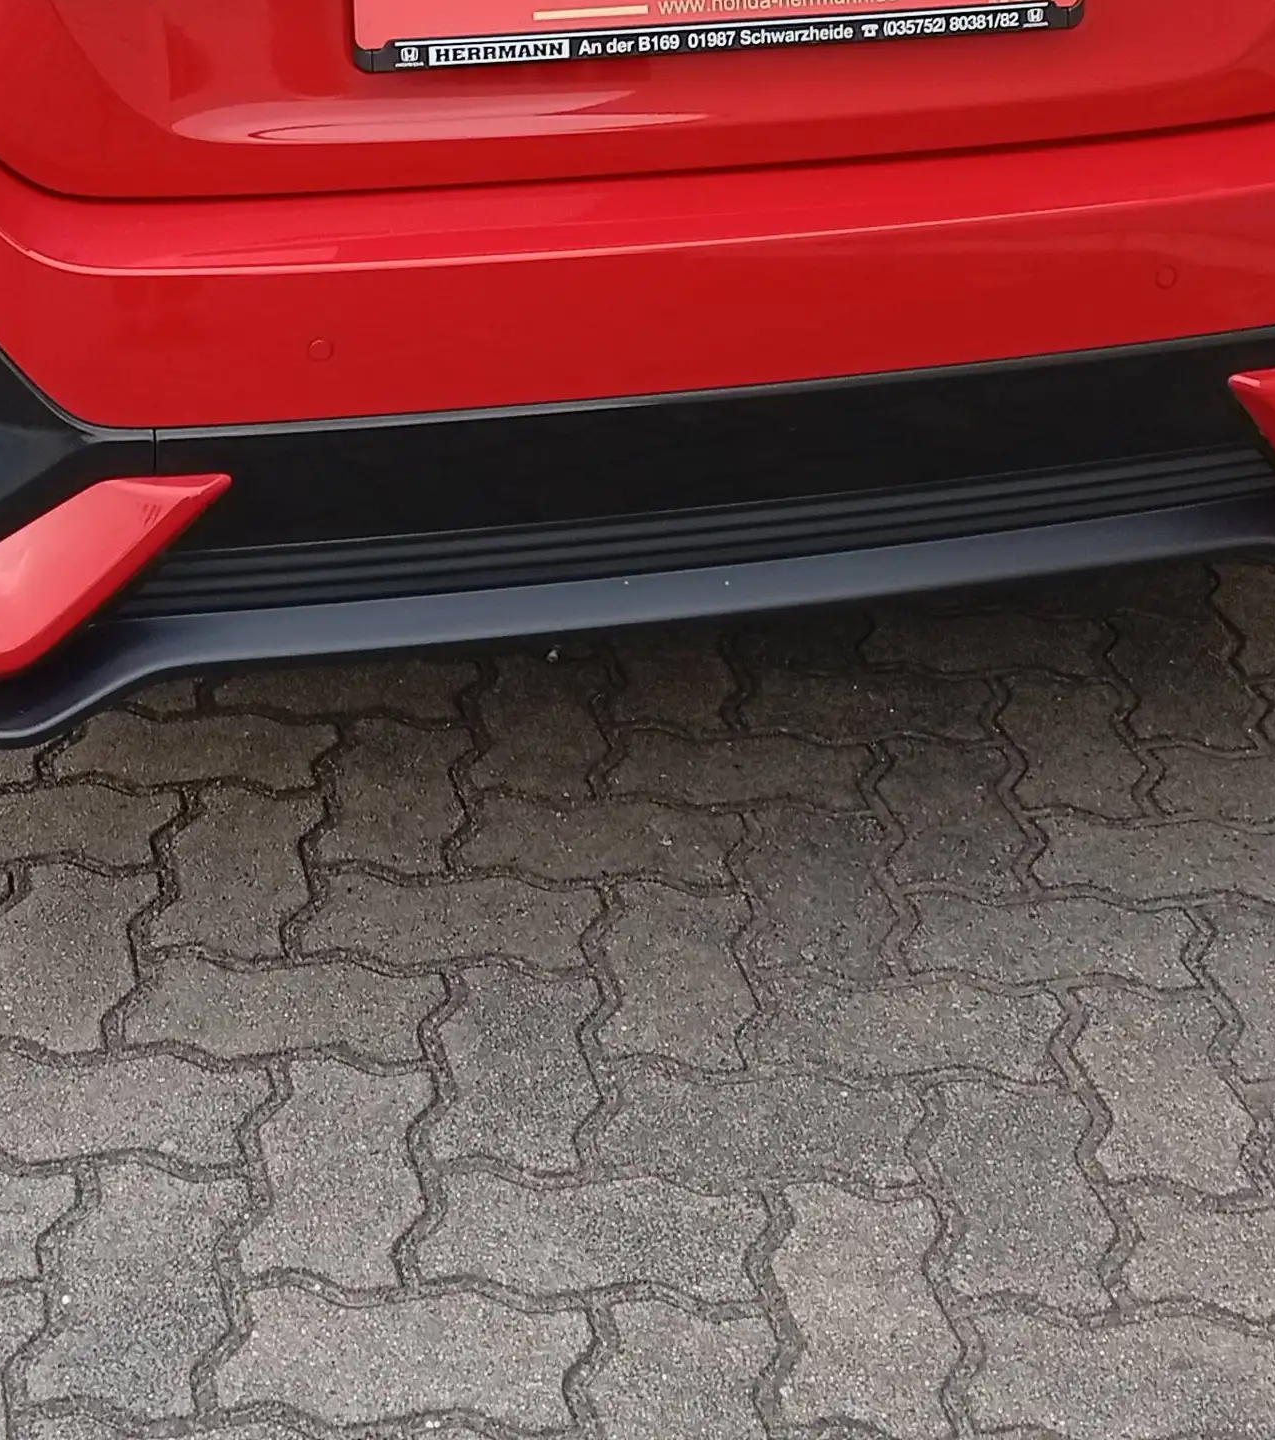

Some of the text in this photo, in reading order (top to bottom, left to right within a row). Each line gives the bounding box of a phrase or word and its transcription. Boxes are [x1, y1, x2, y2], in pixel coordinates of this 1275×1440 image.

[435, 12, 1020, 63] HERRMANN An der B169 01987 Schwarzheide (035752) 80381/82
